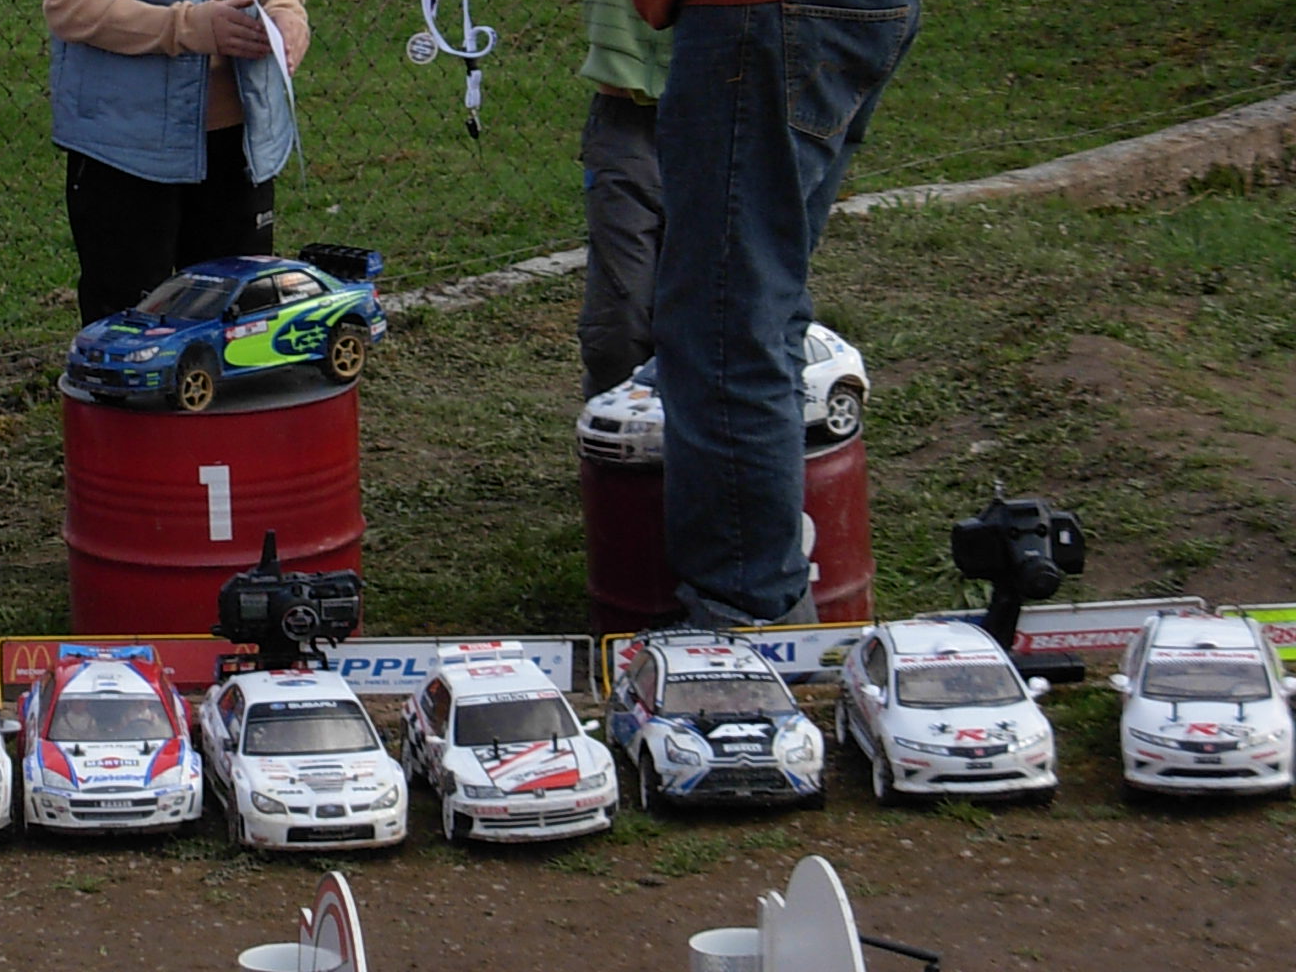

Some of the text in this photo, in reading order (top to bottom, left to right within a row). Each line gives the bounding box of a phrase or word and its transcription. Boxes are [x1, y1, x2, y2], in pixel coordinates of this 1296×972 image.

[199, 465, 232, 540] 1
[341, 658, 428, 677] PPL
[288, 701, 337, 710] SUBARU
[85, 760, 139, 768] MARTINI
